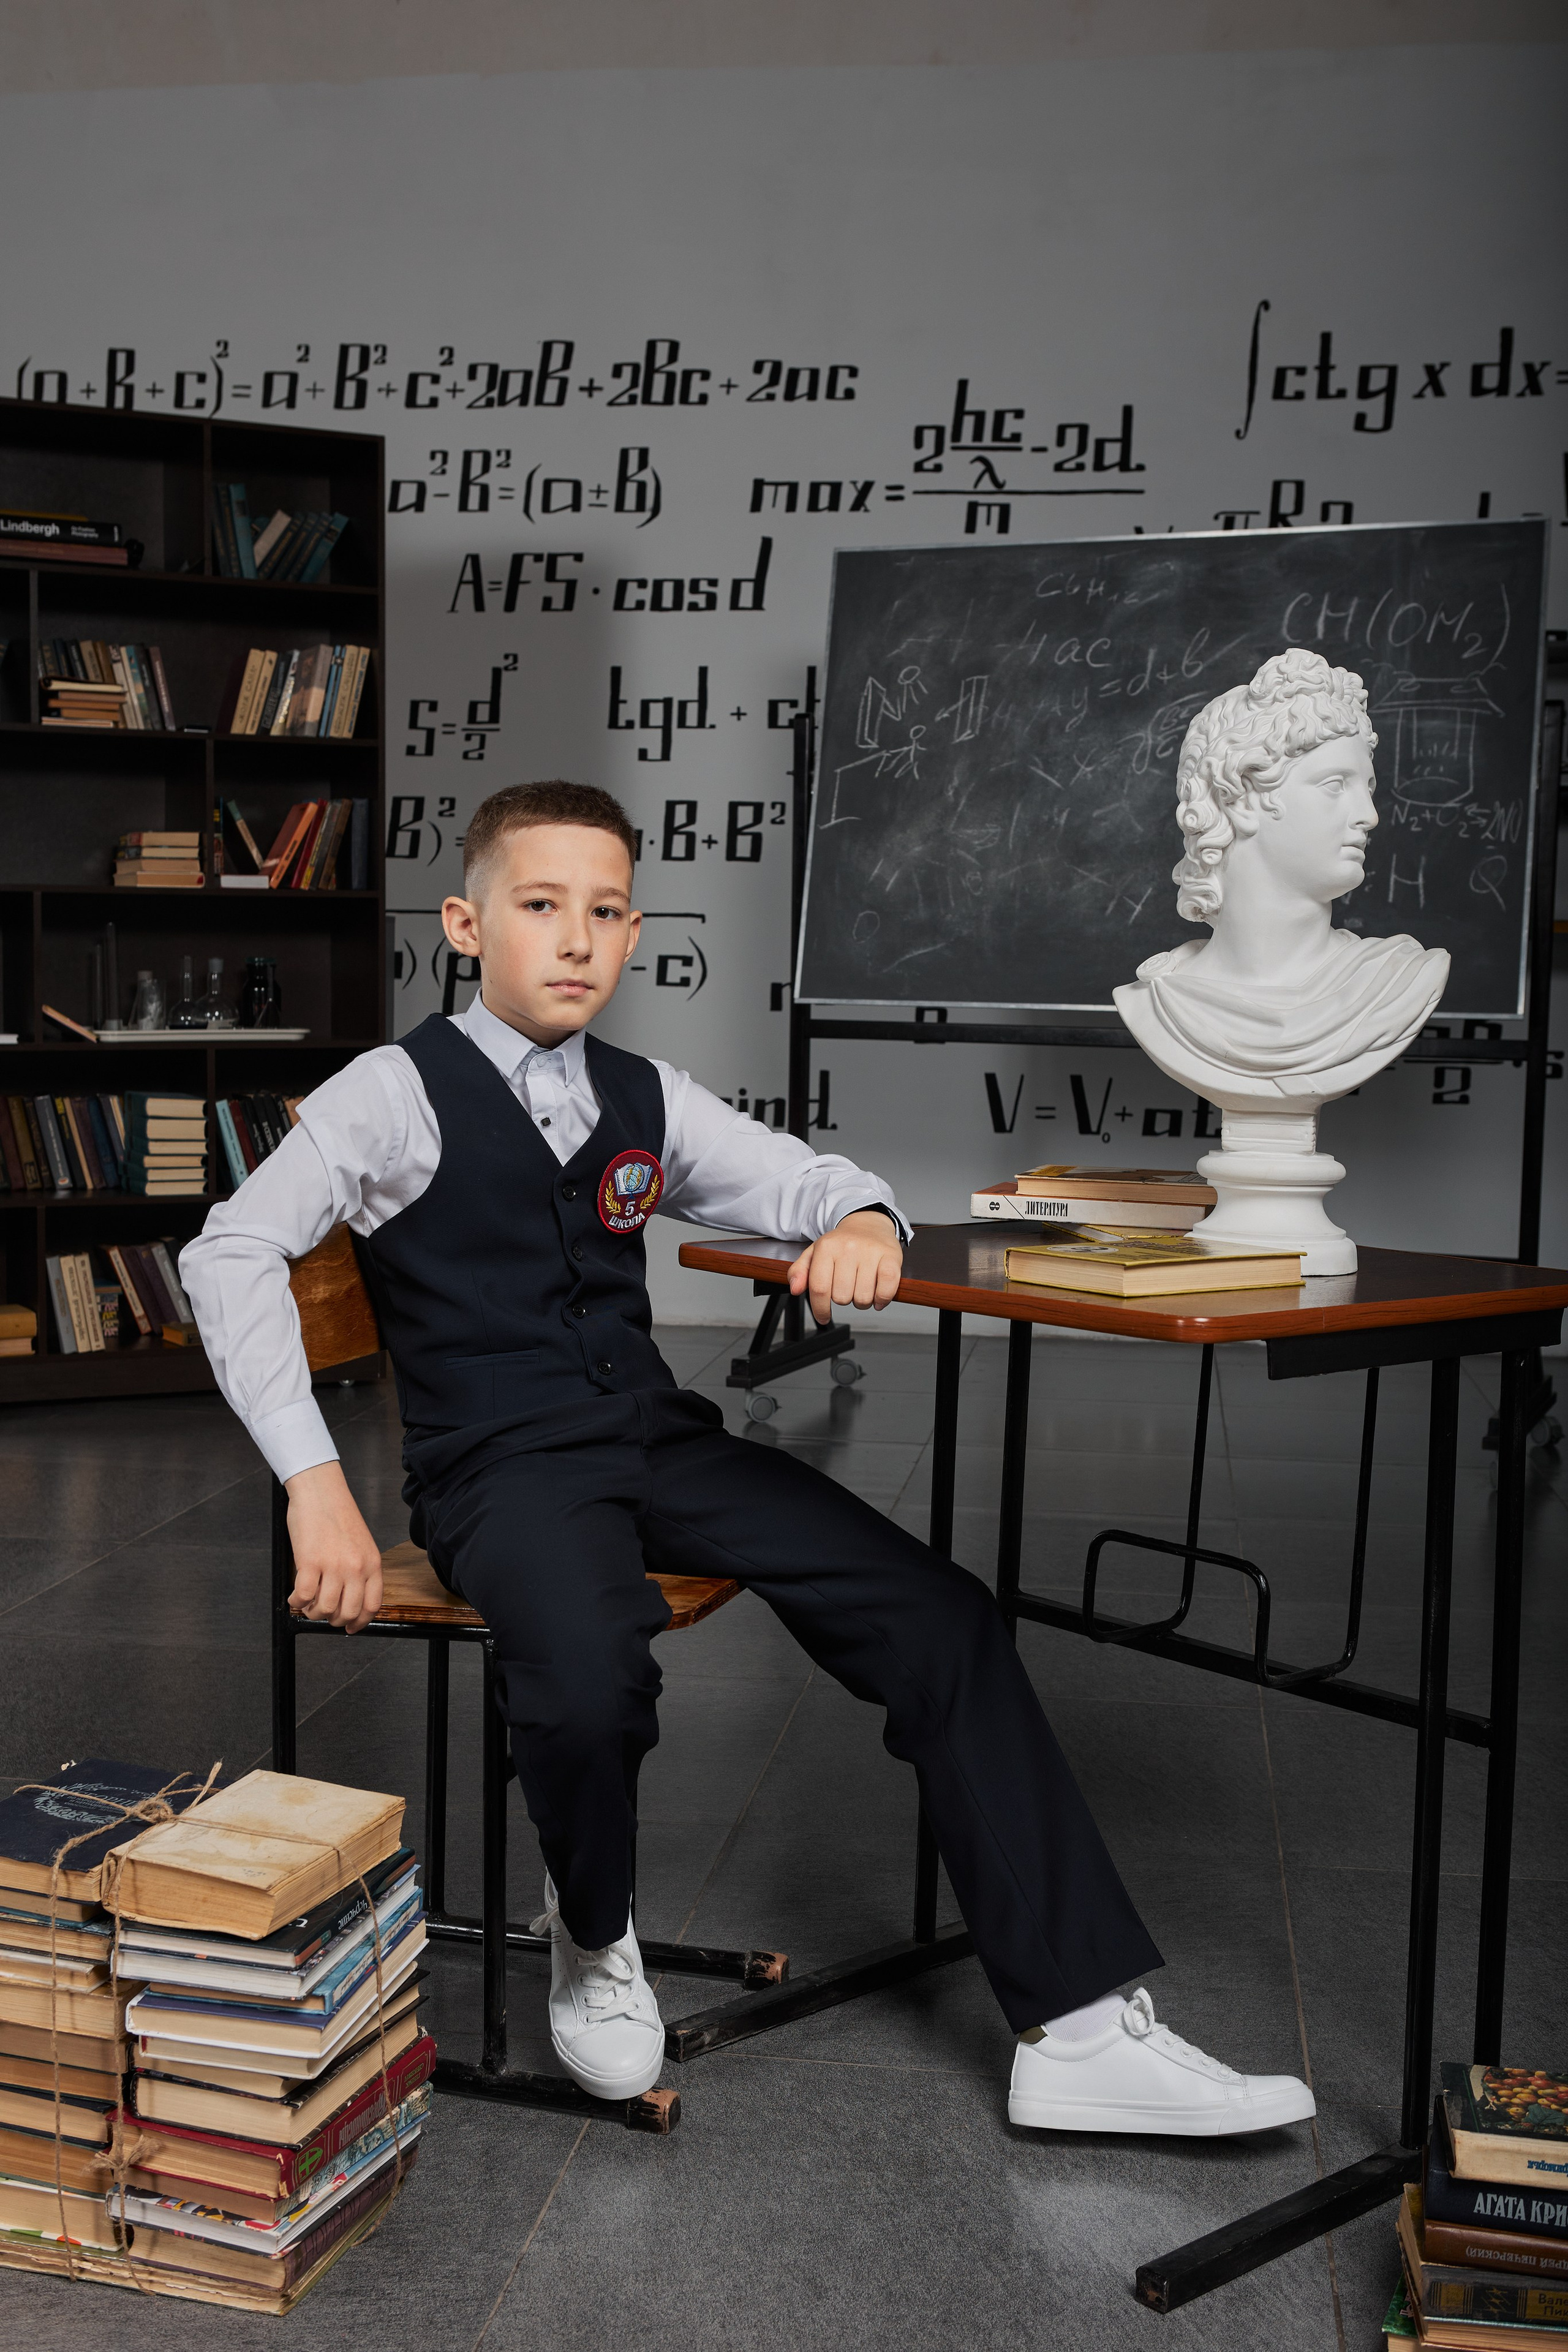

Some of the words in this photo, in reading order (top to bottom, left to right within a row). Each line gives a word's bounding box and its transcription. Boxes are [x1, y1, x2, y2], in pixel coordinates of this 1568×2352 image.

[1, 519, 60, 537] Lindbergh
[625, 1200, 636, 1216] 5
[1025, 1200, 1069, 1218] ЛИТЕРАТУРА
[608, 1212, 646, 1229] ШКОЛА
[337, 1899, 368, 1930] Черчение
[1527, 2160, 1568, 2177] риморья
[1473, 2192, 1526, 2221] АГАТА
[1530, 2200, 1568, 2228] КРИ
[1466, 2245, 1537, 2266] ПЕЧЕРСКИЙ)
